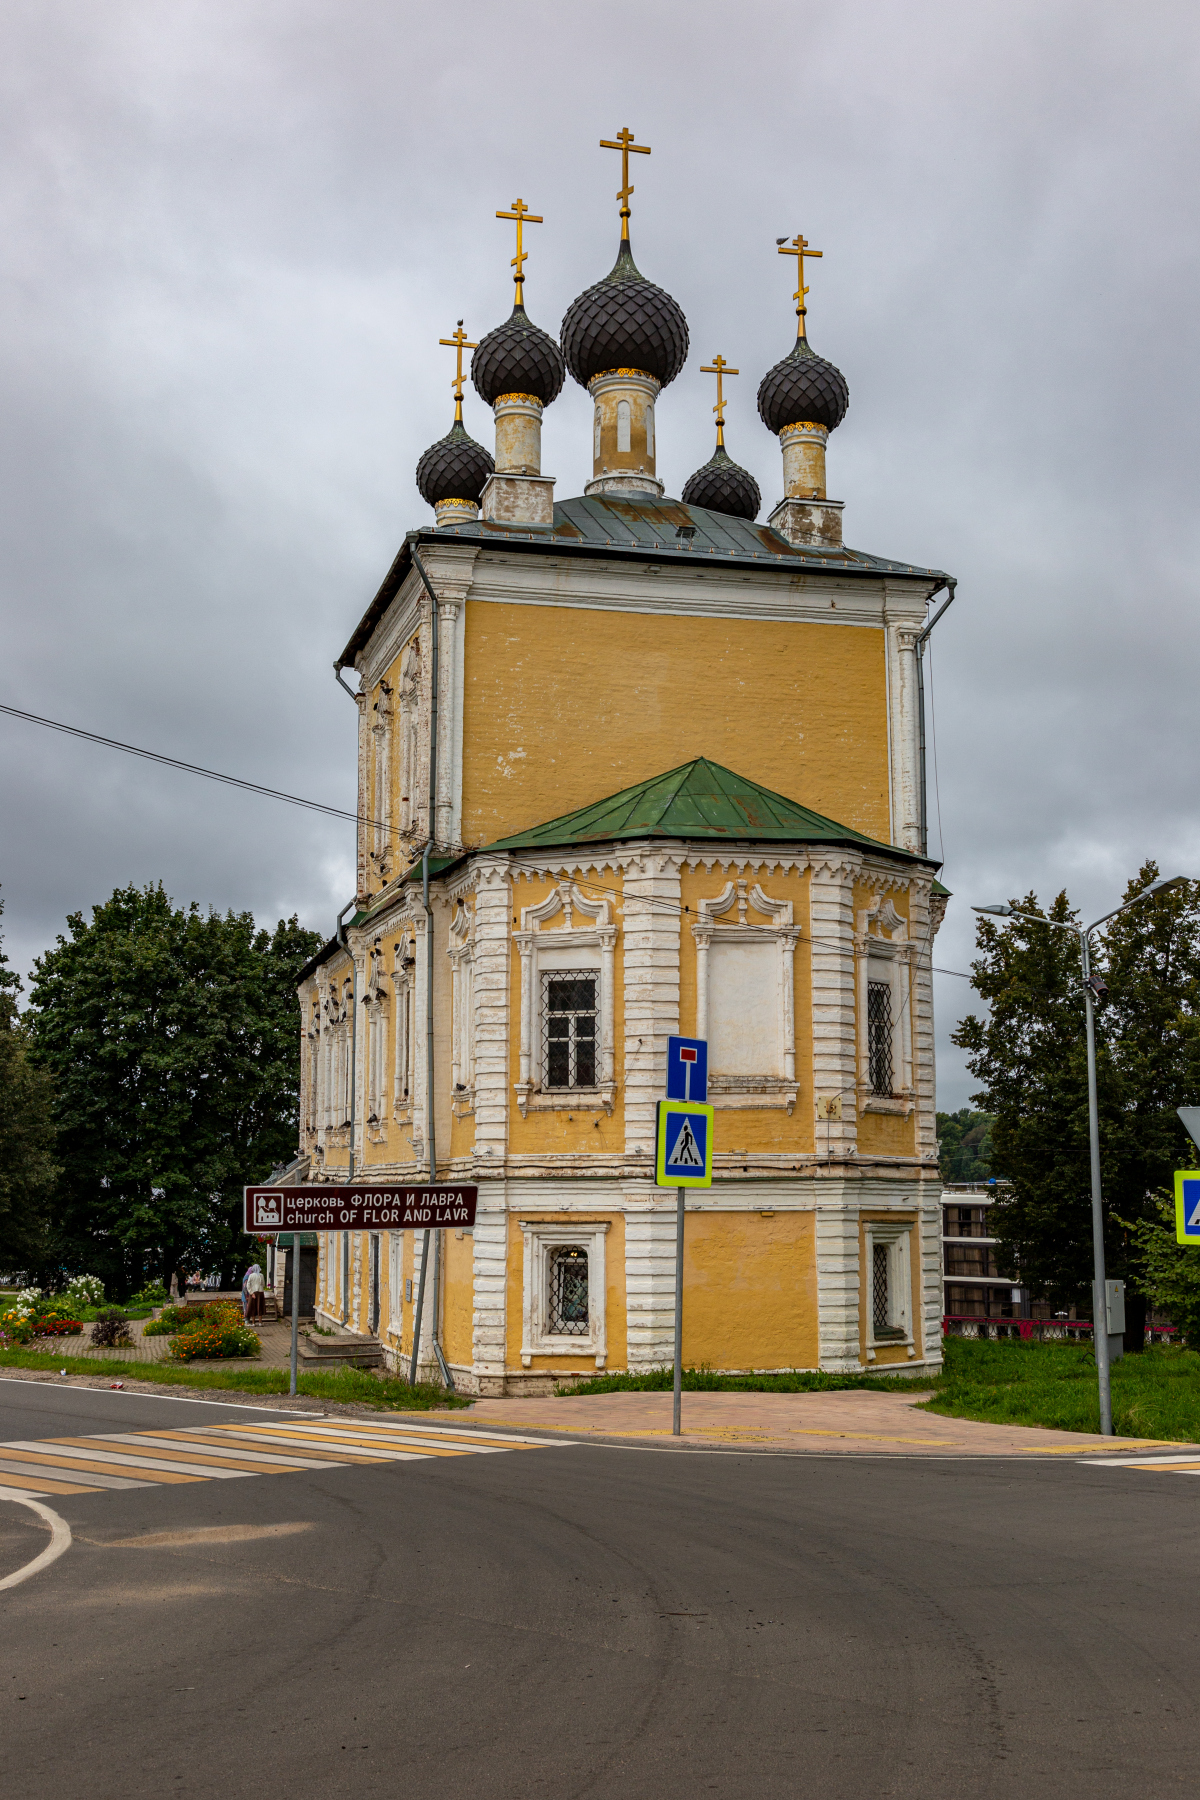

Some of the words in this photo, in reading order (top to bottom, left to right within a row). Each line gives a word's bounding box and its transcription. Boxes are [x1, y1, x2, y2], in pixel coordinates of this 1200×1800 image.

[287, 1197, 344, 1211] церковь
[351, 1194, 400, 1207] ФЛОРА
[406, 1193, 414, 1206] И
[421, 1193, 463, 1206] ЛАВРА
[287, 1211, 333, 1224] church
[340, 1210, 358, 1223] OF
[364, 1209, 399, 1222] FLOR
[404, 1209, 431, 1221] AND
[436, 1208, 468, 1221] LAVR
